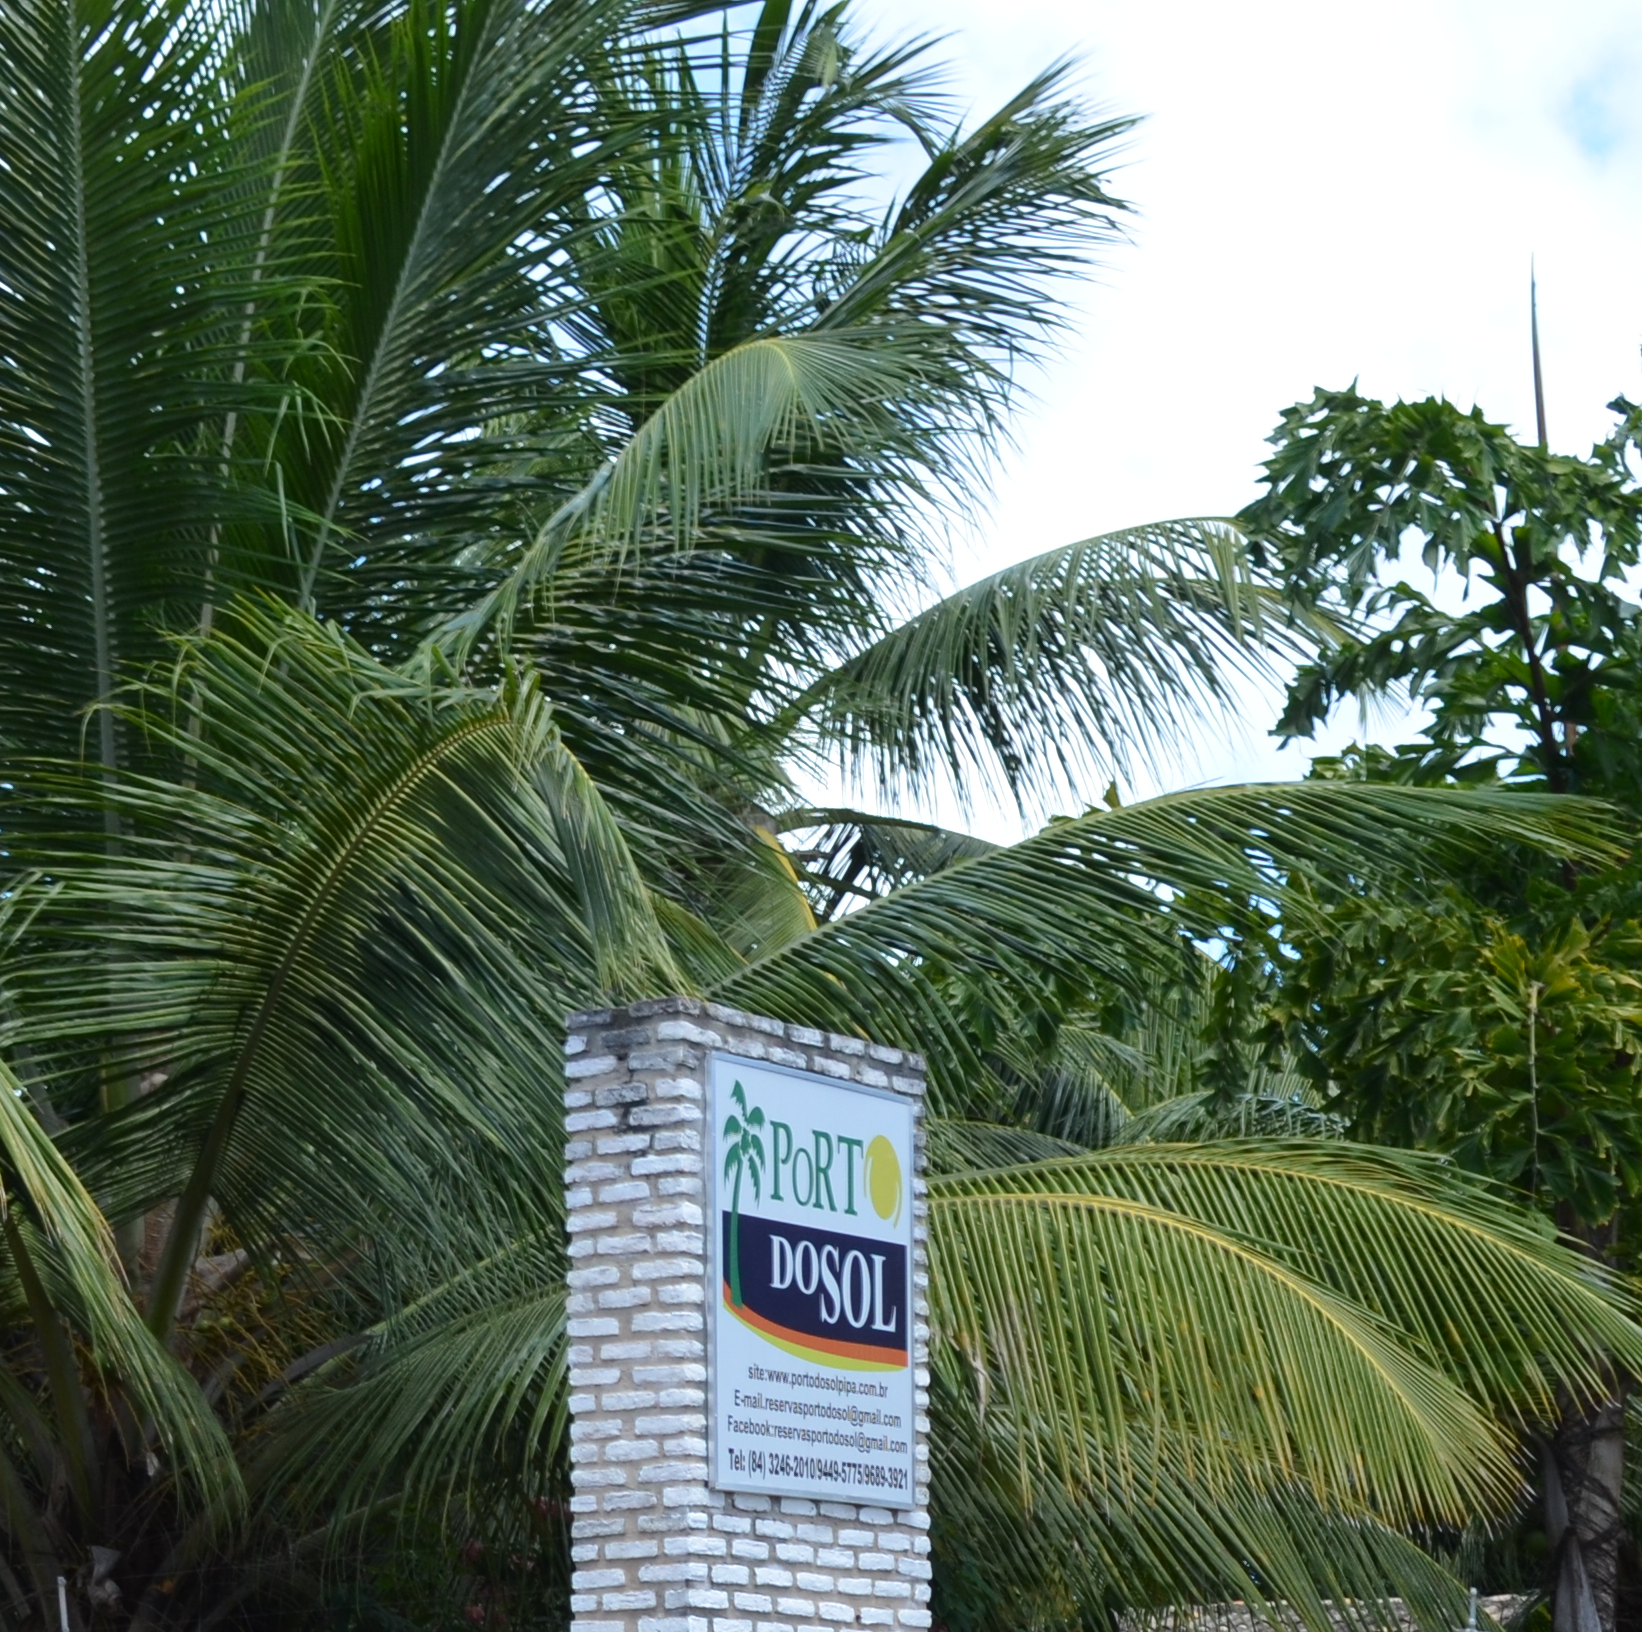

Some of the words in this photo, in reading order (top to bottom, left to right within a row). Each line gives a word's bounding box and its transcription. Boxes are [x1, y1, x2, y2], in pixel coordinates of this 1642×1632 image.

[769, 1234, 897, 1333] DOSOL
[728, 1448, 746, 1471] Tel:
[748, 1450, 766, 1480] (84)
